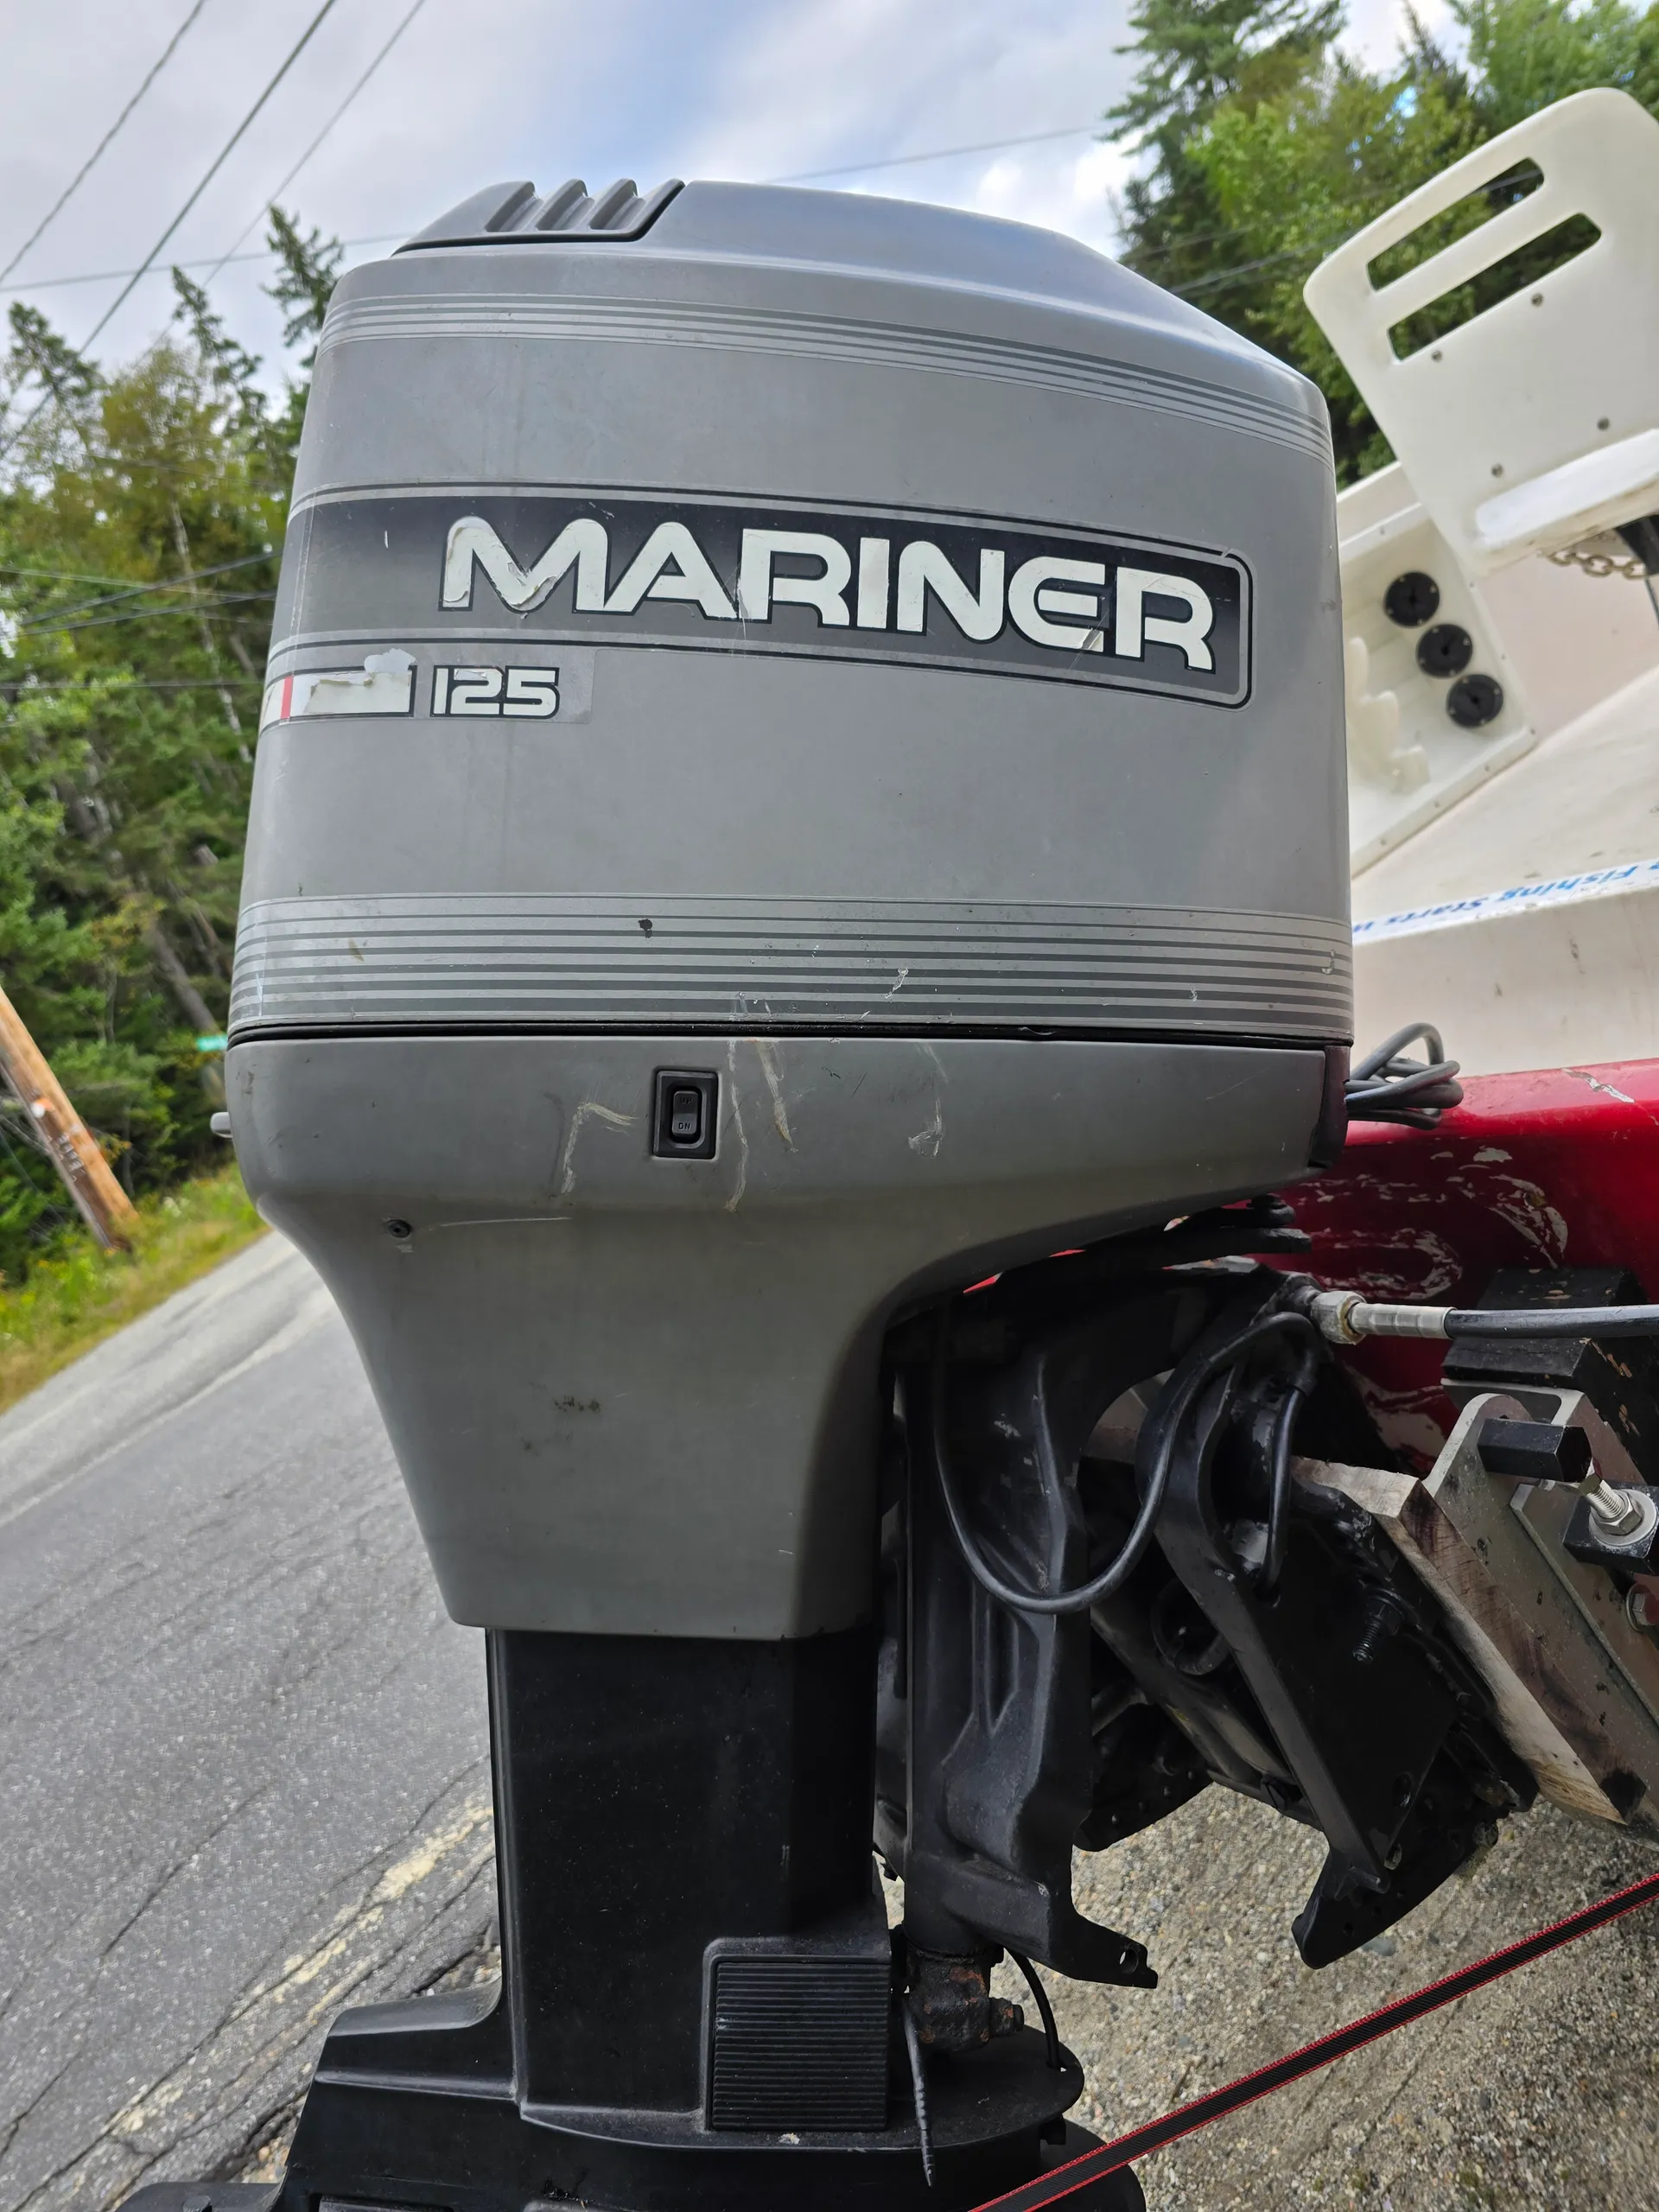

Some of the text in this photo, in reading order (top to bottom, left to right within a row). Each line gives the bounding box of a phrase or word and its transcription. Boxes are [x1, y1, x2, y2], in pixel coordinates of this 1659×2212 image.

[441, 515, 1215, 671] MARINER
[431, 665, 560, 719] 125
[1496, 865, 1638, 902] Fishing
[680, 1096, 694, 1104] UP
